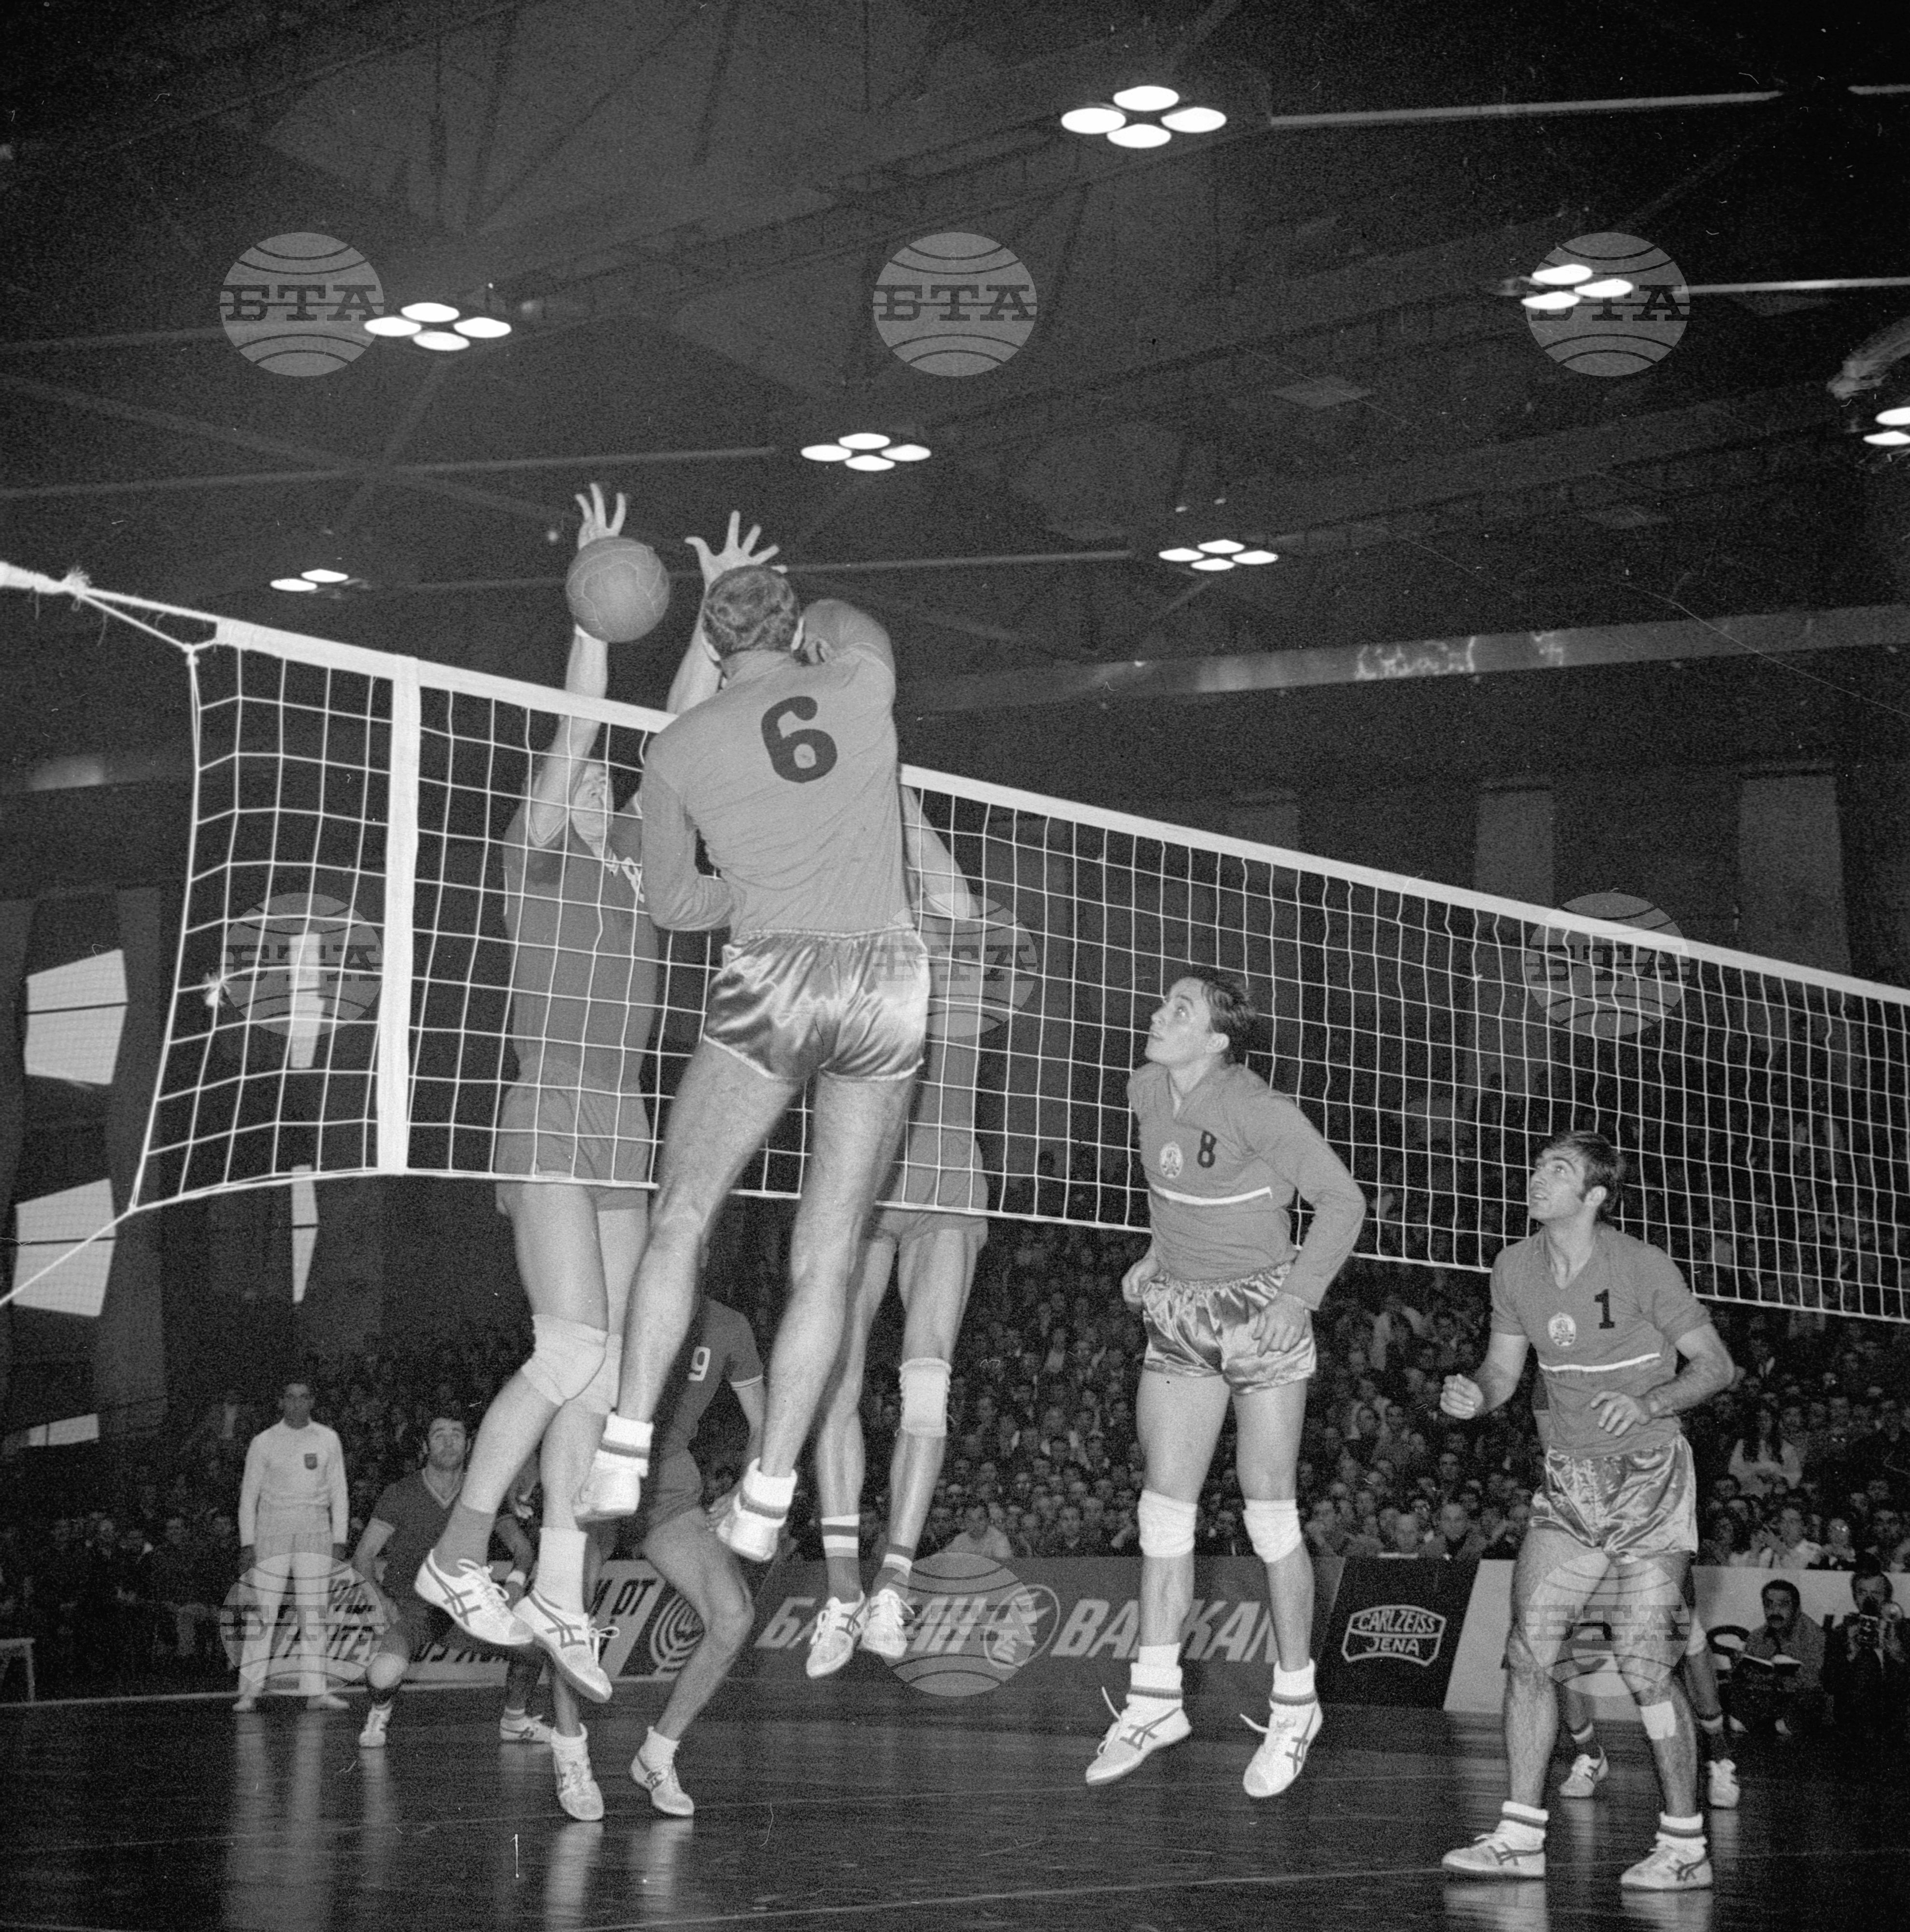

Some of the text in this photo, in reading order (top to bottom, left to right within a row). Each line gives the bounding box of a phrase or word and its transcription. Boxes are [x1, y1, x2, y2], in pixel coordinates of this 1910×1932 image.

[761, 696, 838, 783] 6
[1197, 1131, 1217, 1168] 8
[1595, 1289, 1615, 1329] 1
[688, 1346, 711, 1381] 9
[1050, 1599, 1280, 1663] BAKAN
[1365, 1636, 1419, 1657] JENA
